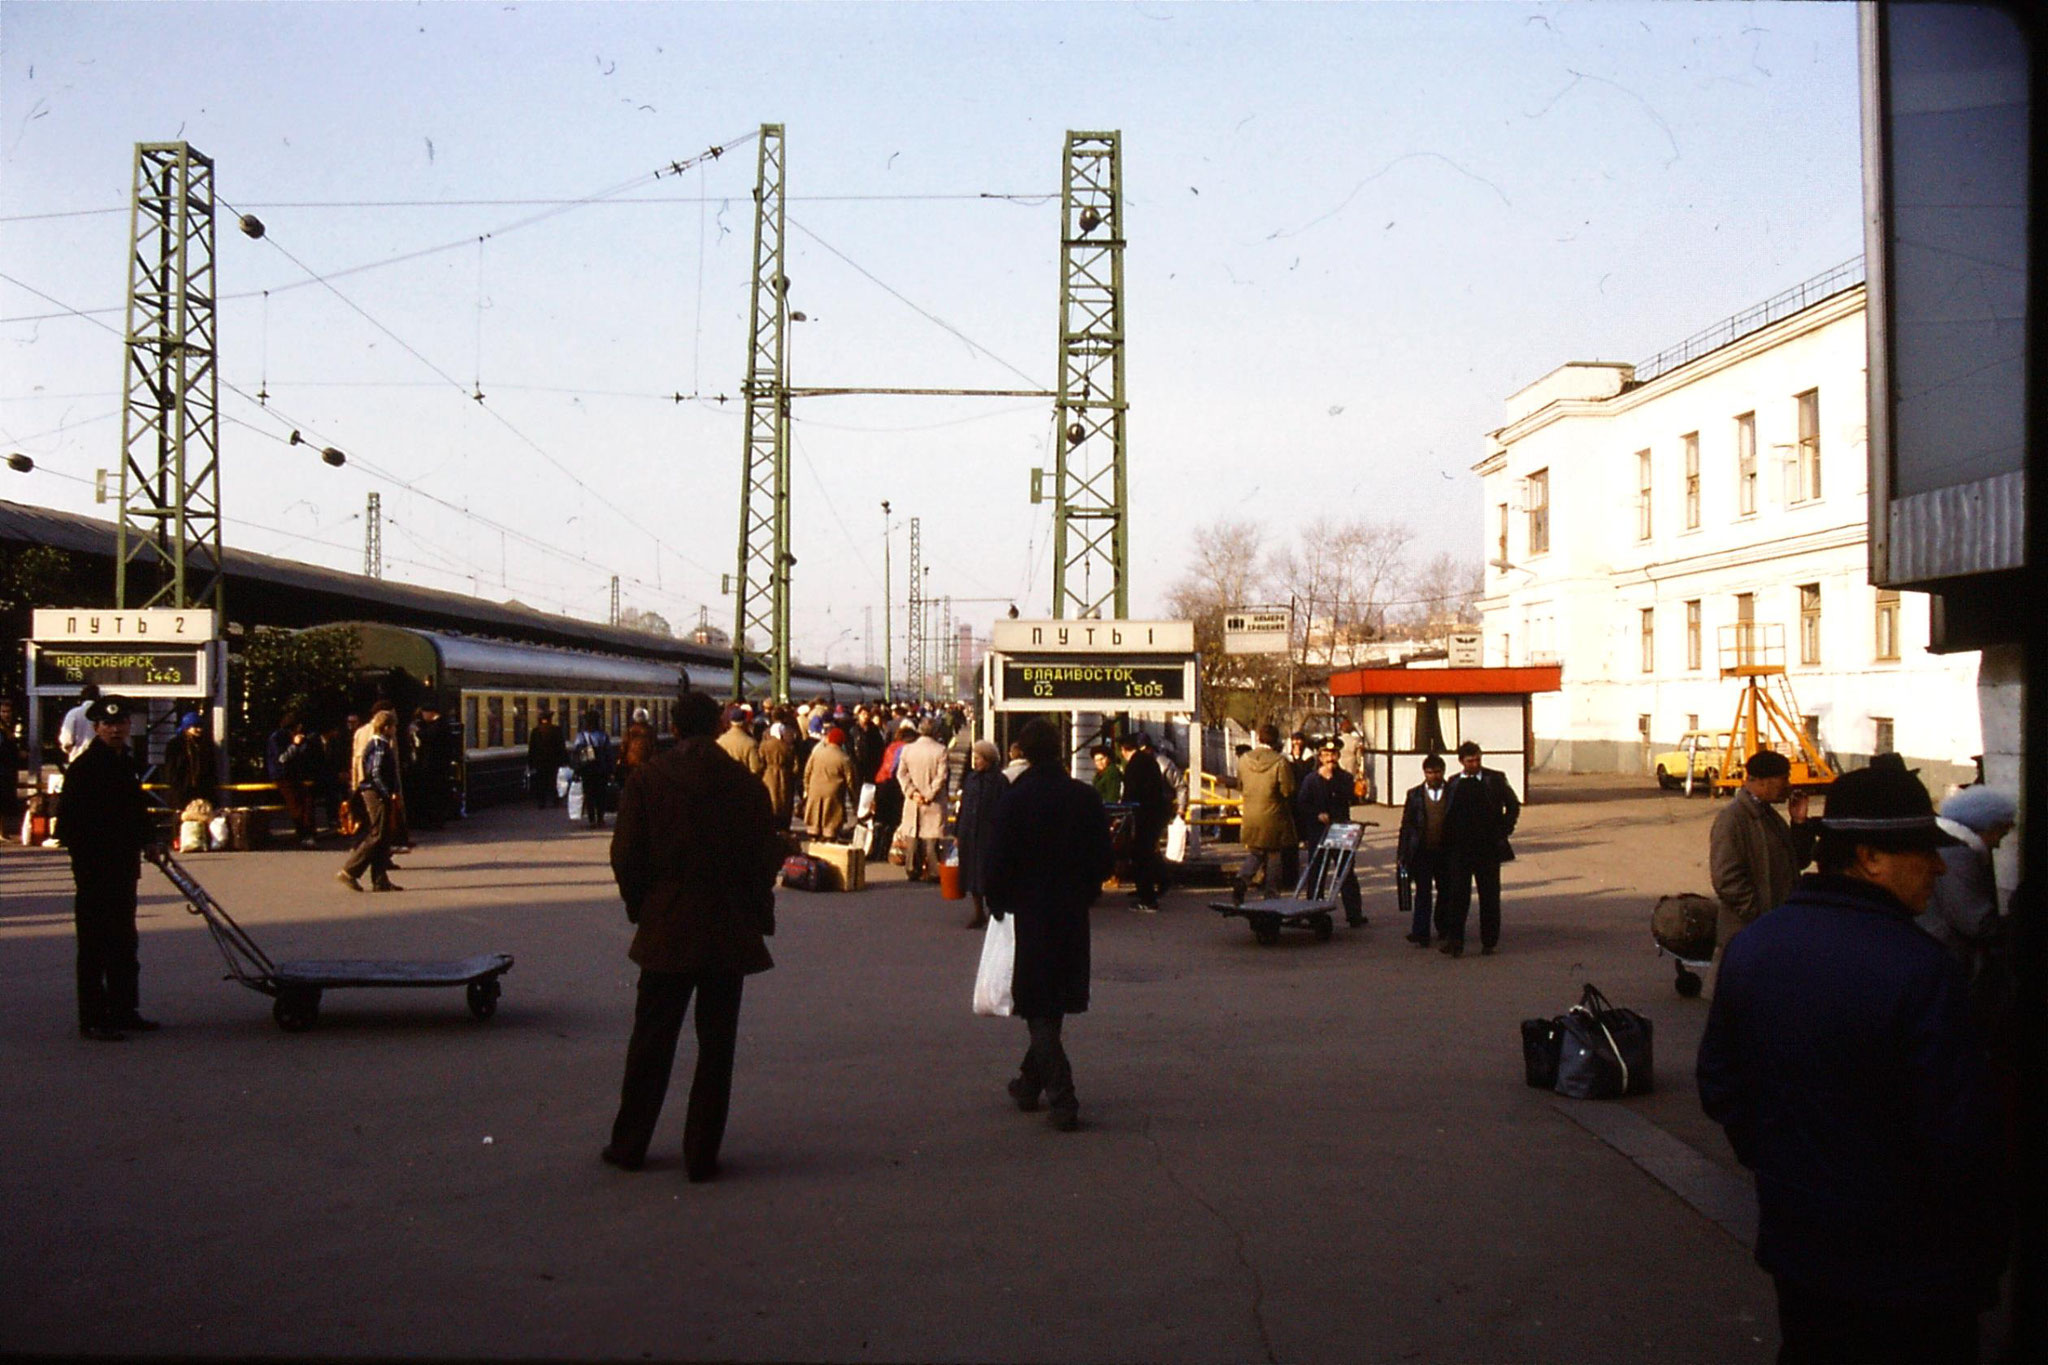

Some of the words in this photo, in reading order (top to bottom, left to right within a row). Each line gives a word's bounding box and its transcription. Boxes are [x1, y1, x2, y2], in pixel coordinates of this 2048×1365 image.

[67, 617, 147, 633] ПУТЬ
[175, 617, 184, 633] 2
[1032, 628, 1122, 645] ПУТЬ
[57, 656, 154, 667] НОВОСИБИРСК
[146, 671, 181, 682] 1443
[1024, 668, 1133, 681] ВЛАДИВОСТОК
[1033, 684, 1053, 696] 02
[1125, 684, 1164, 697] 1505
